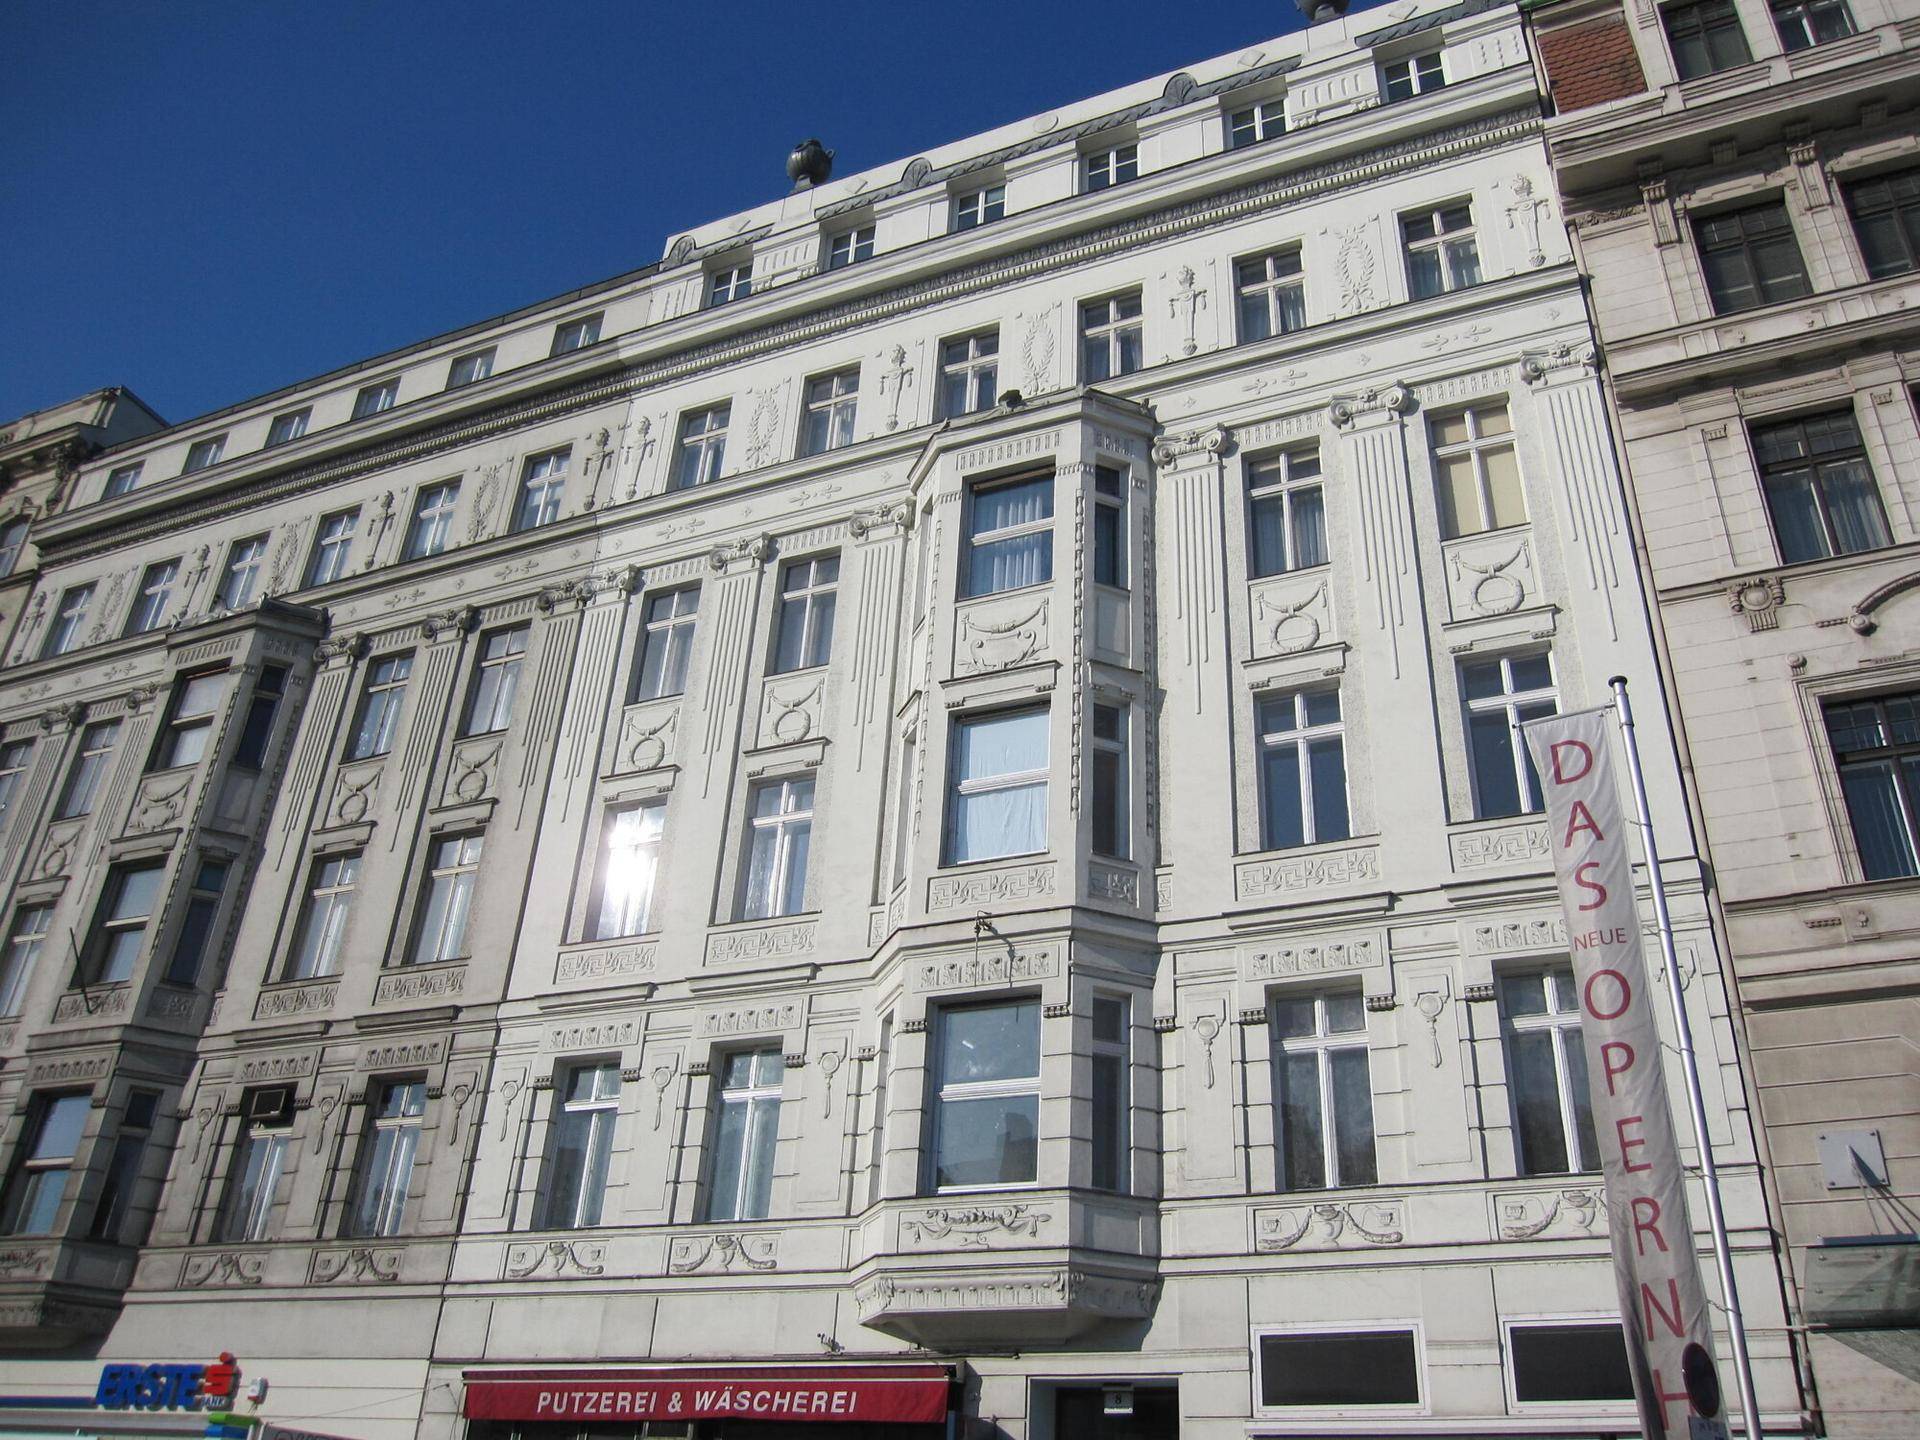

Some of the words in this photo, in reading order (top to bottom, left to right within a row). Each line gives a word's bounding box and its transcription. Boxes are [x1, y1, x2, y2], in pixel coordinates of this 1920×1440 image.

[1549, 739, 1608, 912] DAS
[1573, 927, 1628, 952] NEUE
[96, 1363, 207, 1409] ERSTE
[536, 1391, 658, 1414] PUTZEREI
[667, 1391, 683, 1413] &
[694, 1386, 858, 1414] WÄSCHEREI
